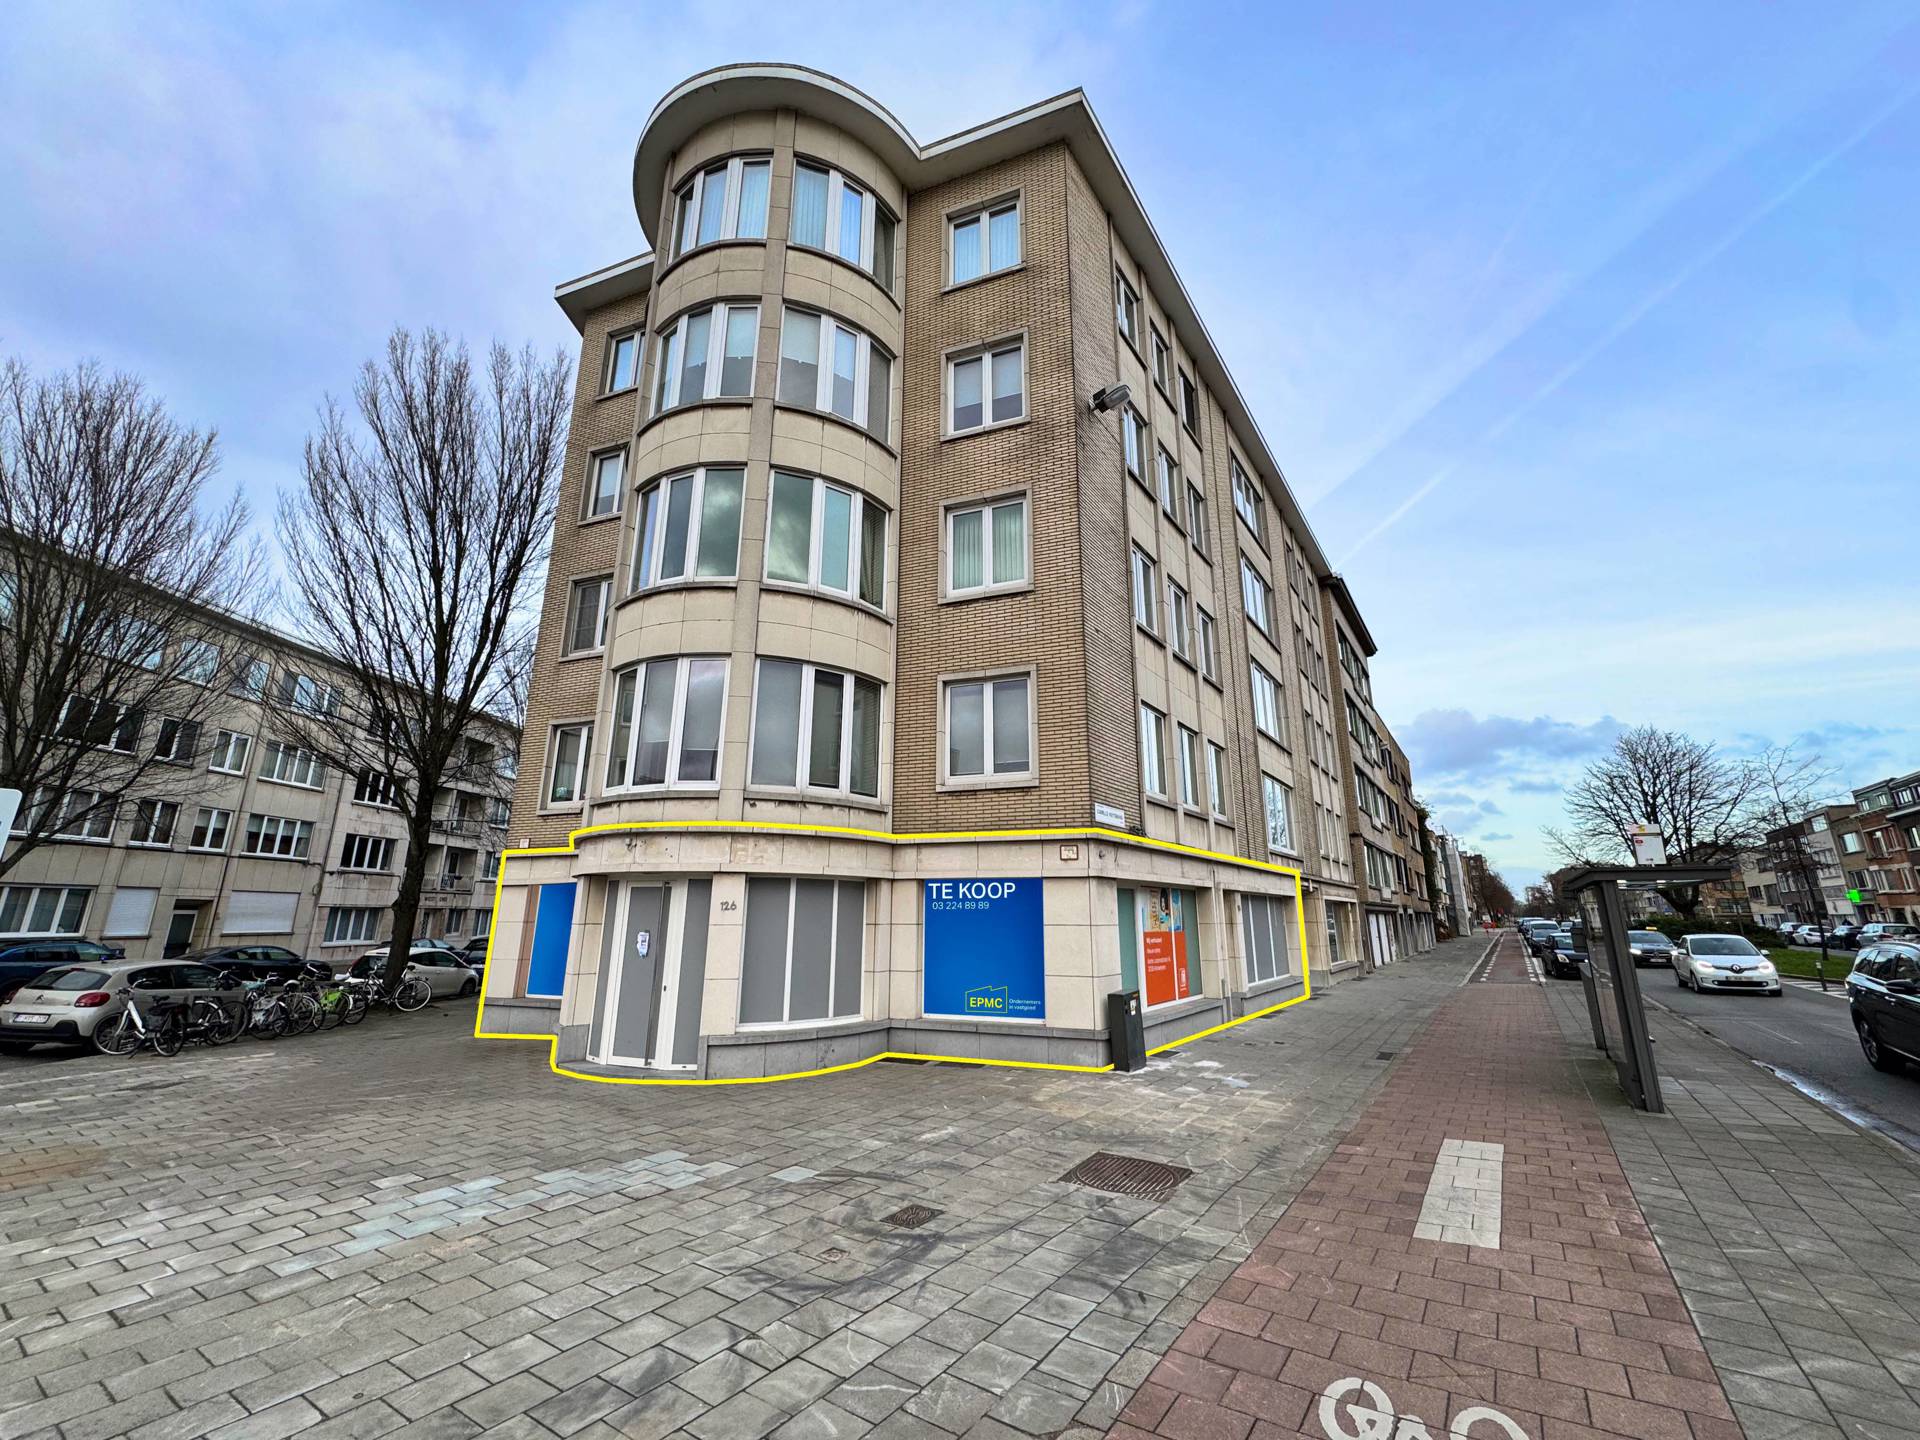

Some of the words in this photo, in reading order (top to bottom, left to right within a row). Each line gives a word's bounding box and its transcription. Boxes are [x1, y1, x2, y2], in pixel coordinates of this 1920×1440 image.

[928, 883, 953, 899] TE
[959, 882, 1016, 899] KOOP
[720, 901, 737, 911] 126
[969, 997, 1003, 1008] EPMC
